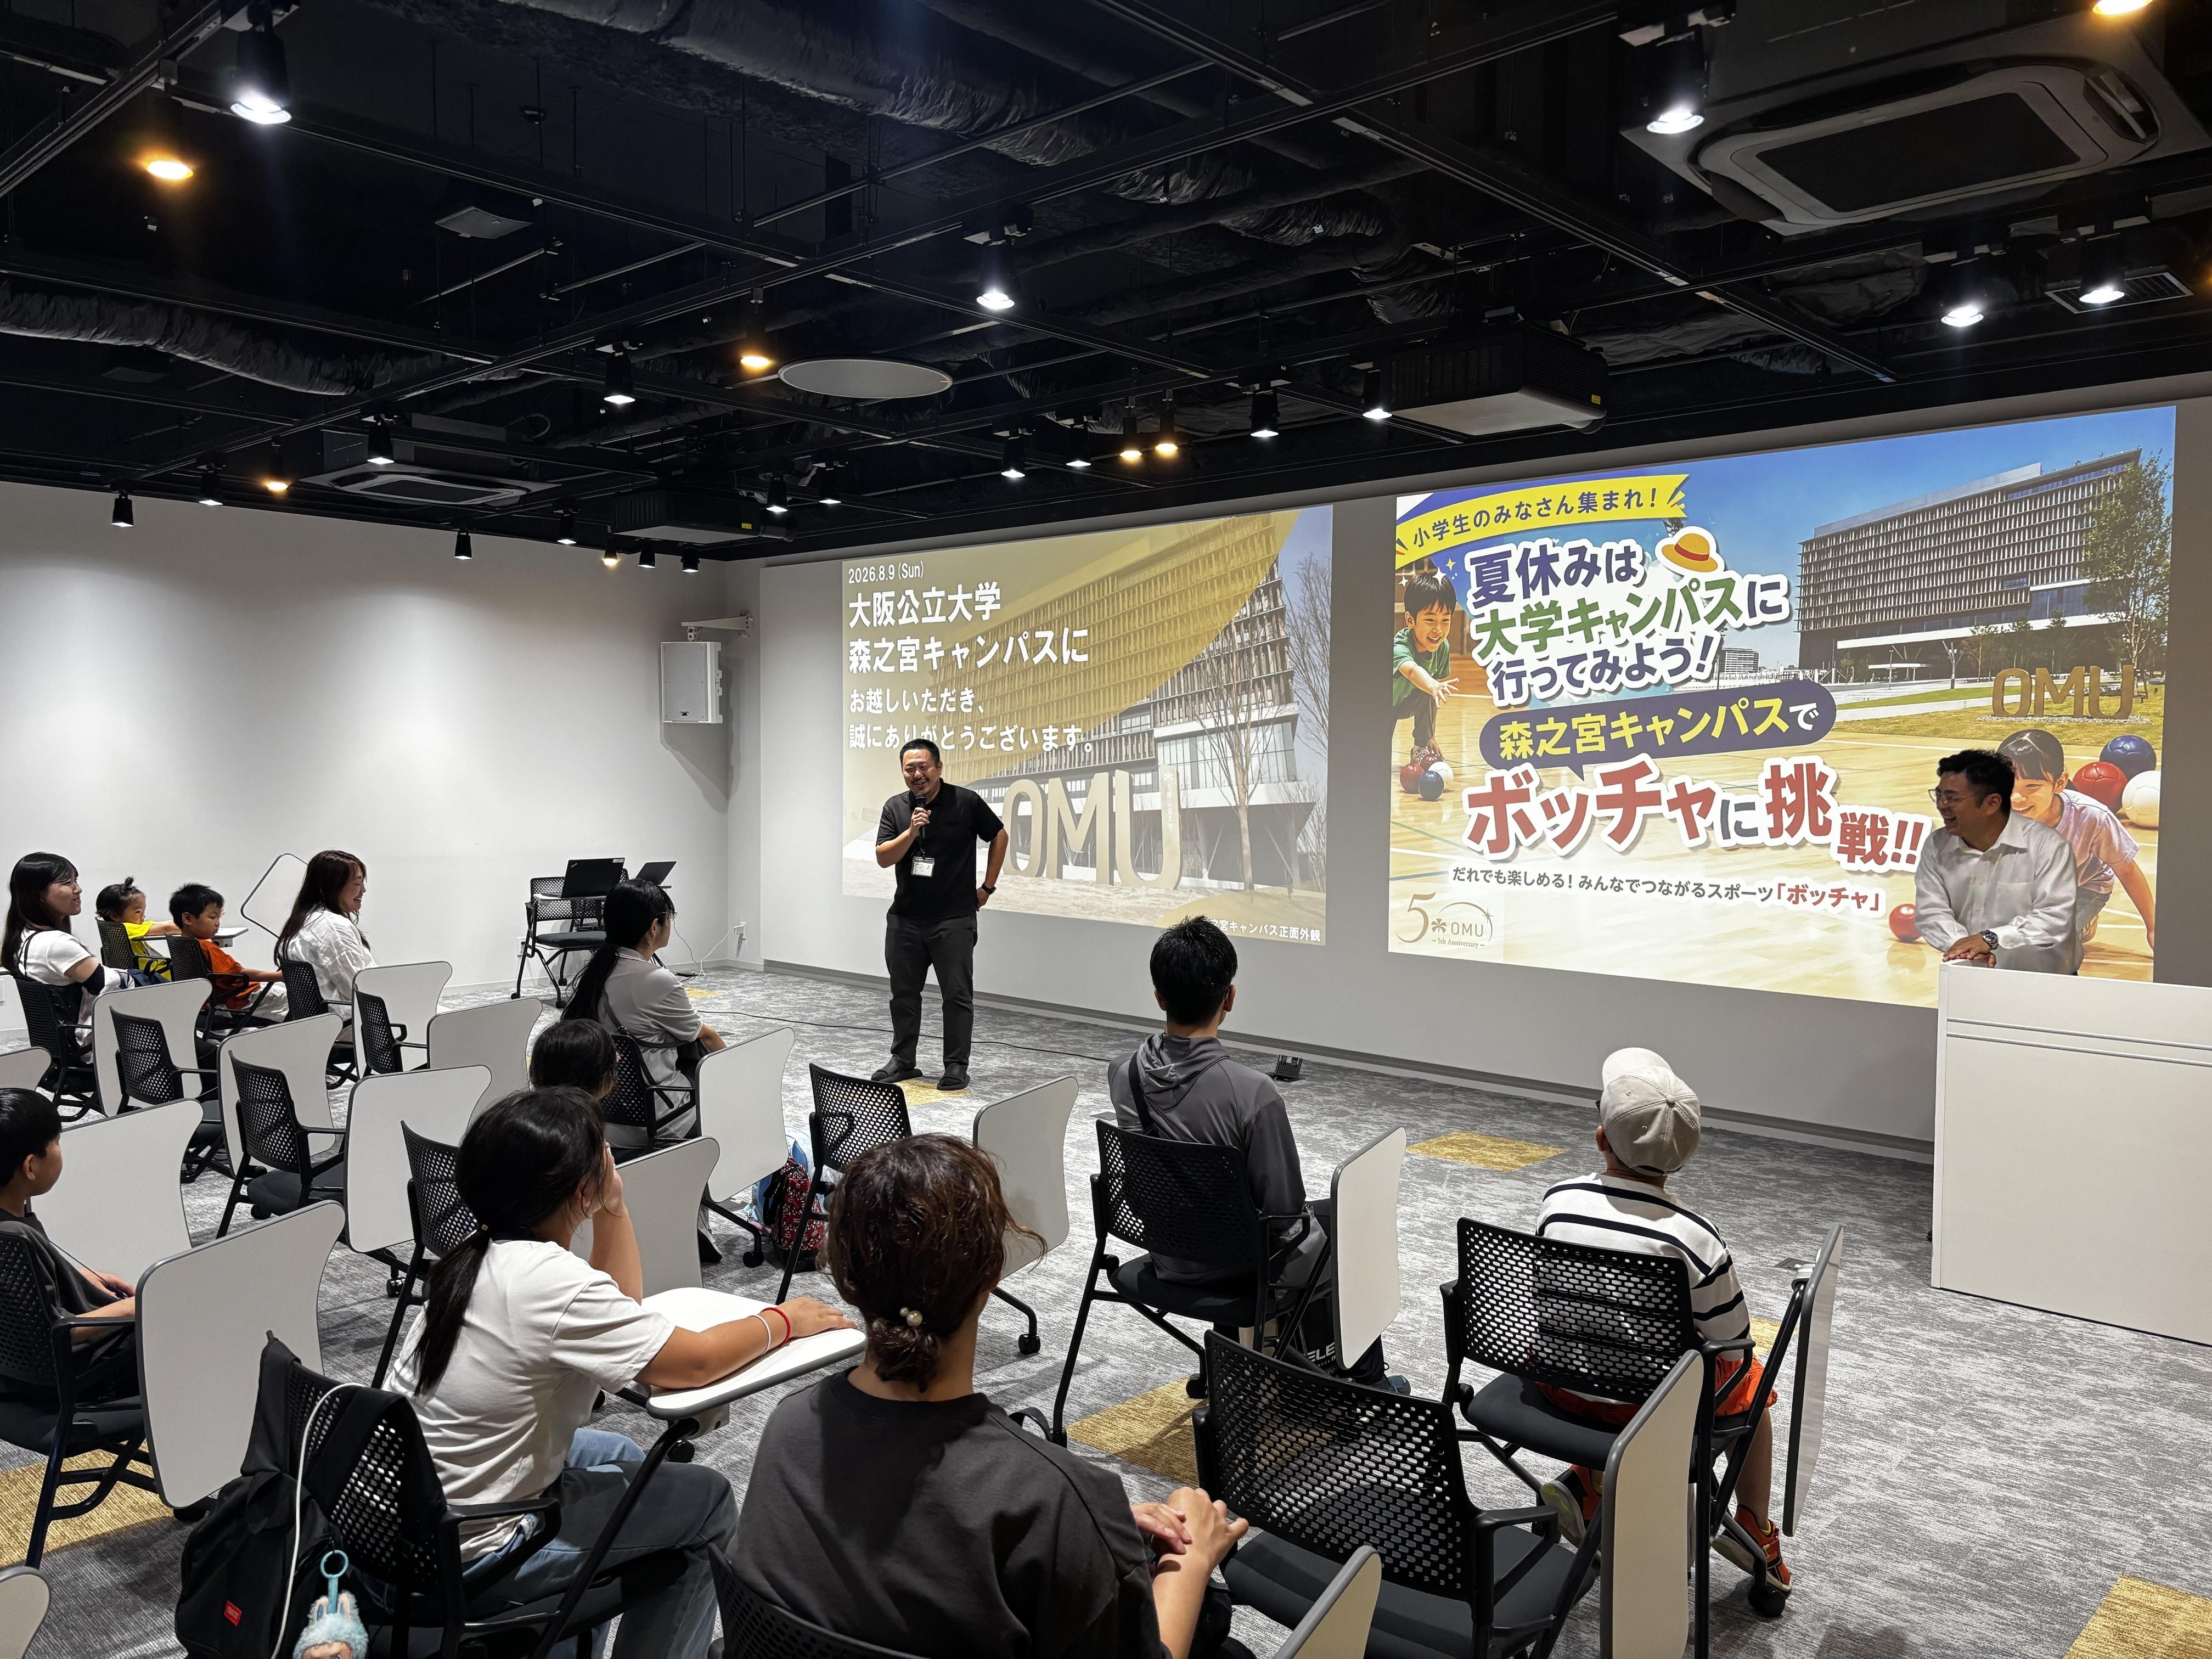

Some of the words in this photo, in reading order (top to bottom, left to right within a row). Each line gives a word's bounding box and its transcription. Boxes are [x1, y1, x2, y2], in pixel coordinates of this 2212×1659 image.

[1414, 487, 1656, 547] 小学生のみなさん集まれ！
[848, 564, 895, 584] 2026.8.9
[898, 560, 924, 580] (Sun)
[1470, 544, 1638, 609] 夏休みは
[848, 581, 1000, 628] 大阪公立大学
[1476, 577, 1781, 660] 大学キャンパスに
[849, 627, 1088, 674] 森之宮キャンパスに
[1492, 635, 1713, 700] 行ってみよう！
[849, 687, 984, 714] お越しいただき、
[1993, 665, 2134, 719] OMU
[849, 723, 1093, 753] 誠にありがとうございます。
[1499, 698, 1819, 761] 森之宮キャンパスで
[1002, 765, 1183, 890] OMU
[1448, 939, 1479, 948] Anniversary
[1451, 922, 1483, 937] OMU
